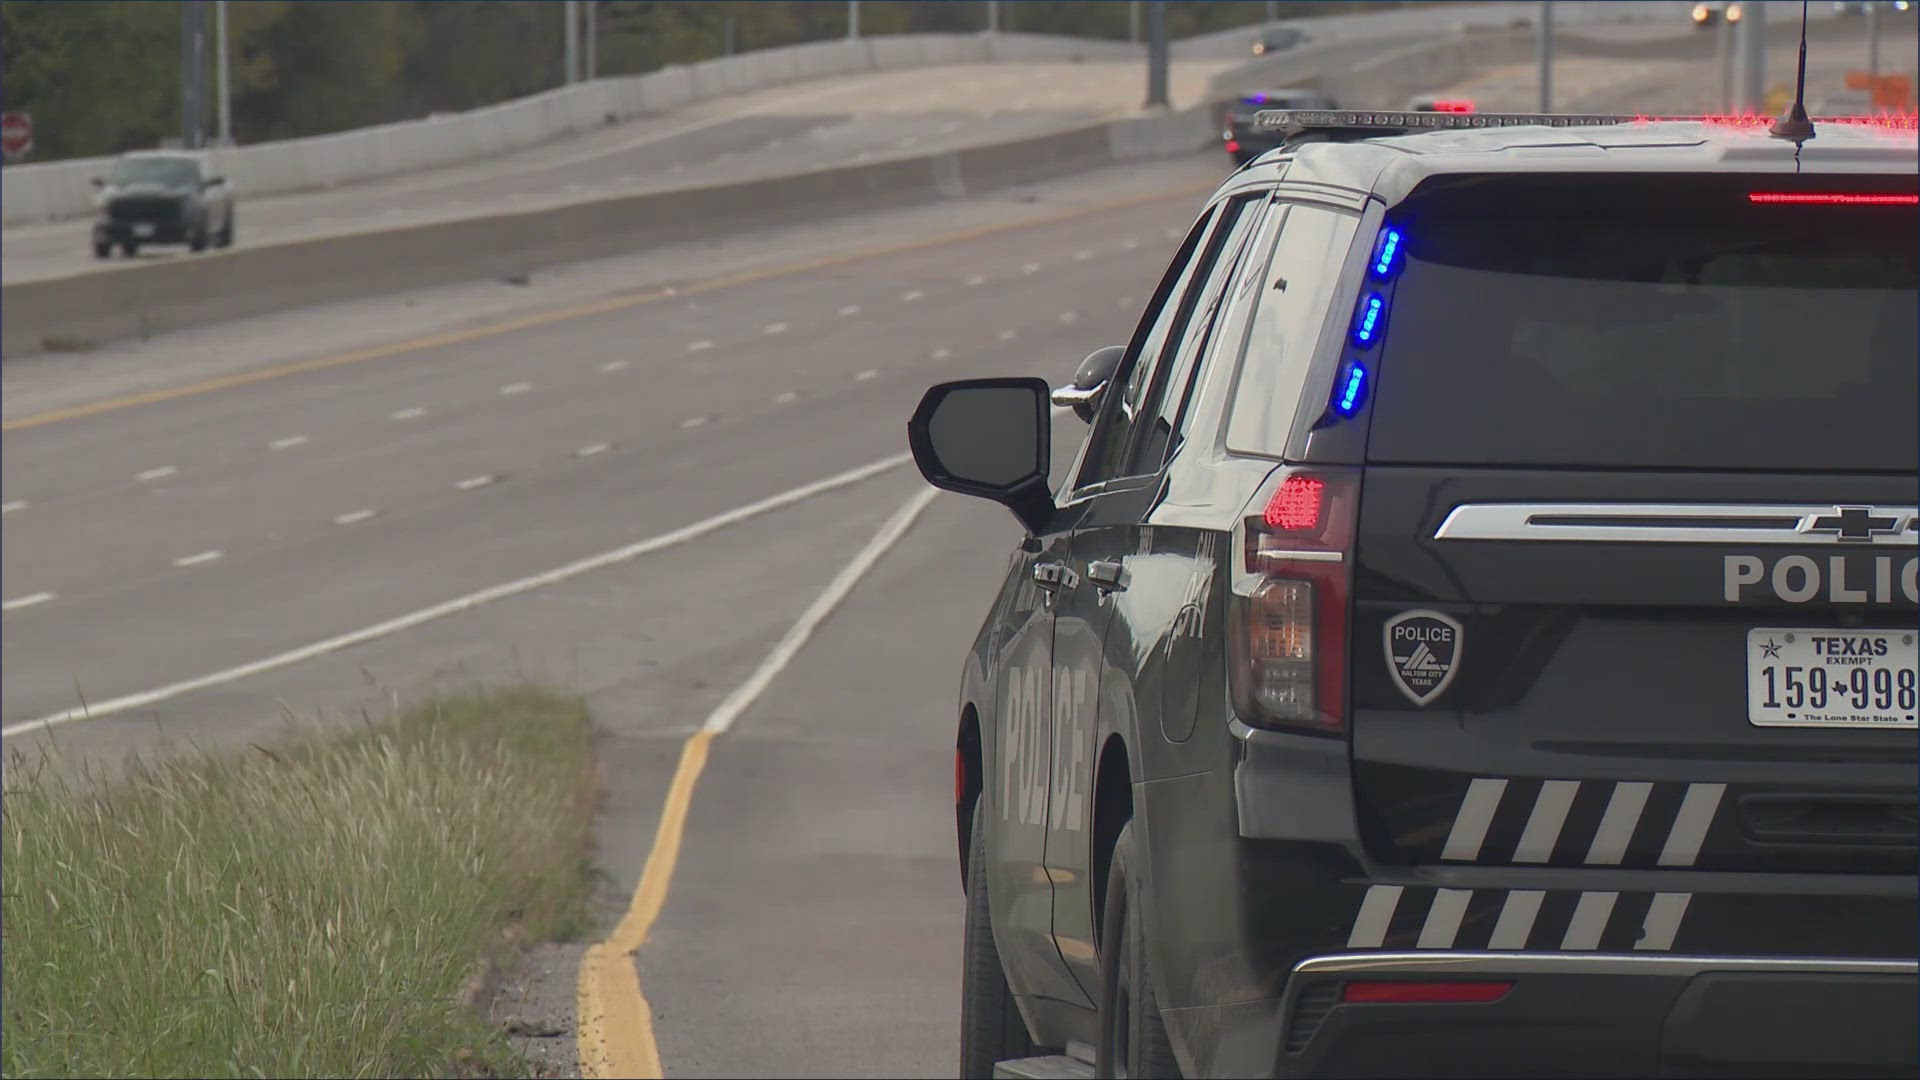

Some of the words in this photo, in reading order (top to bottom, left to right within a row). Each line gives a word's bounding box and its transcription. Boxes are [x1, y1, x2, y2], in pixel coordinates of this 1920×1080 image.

[1395, 626, 1452, 642] POLICE
[1811, 637, 1888, 656] TEXAS
[1826, 656, 1873, 666] EXEMPT
[1412, 678, 1432, 686] TEXAS
[1850, 714, 1870, 722] Star
[1003, 665, 1086, 831] POLICE
